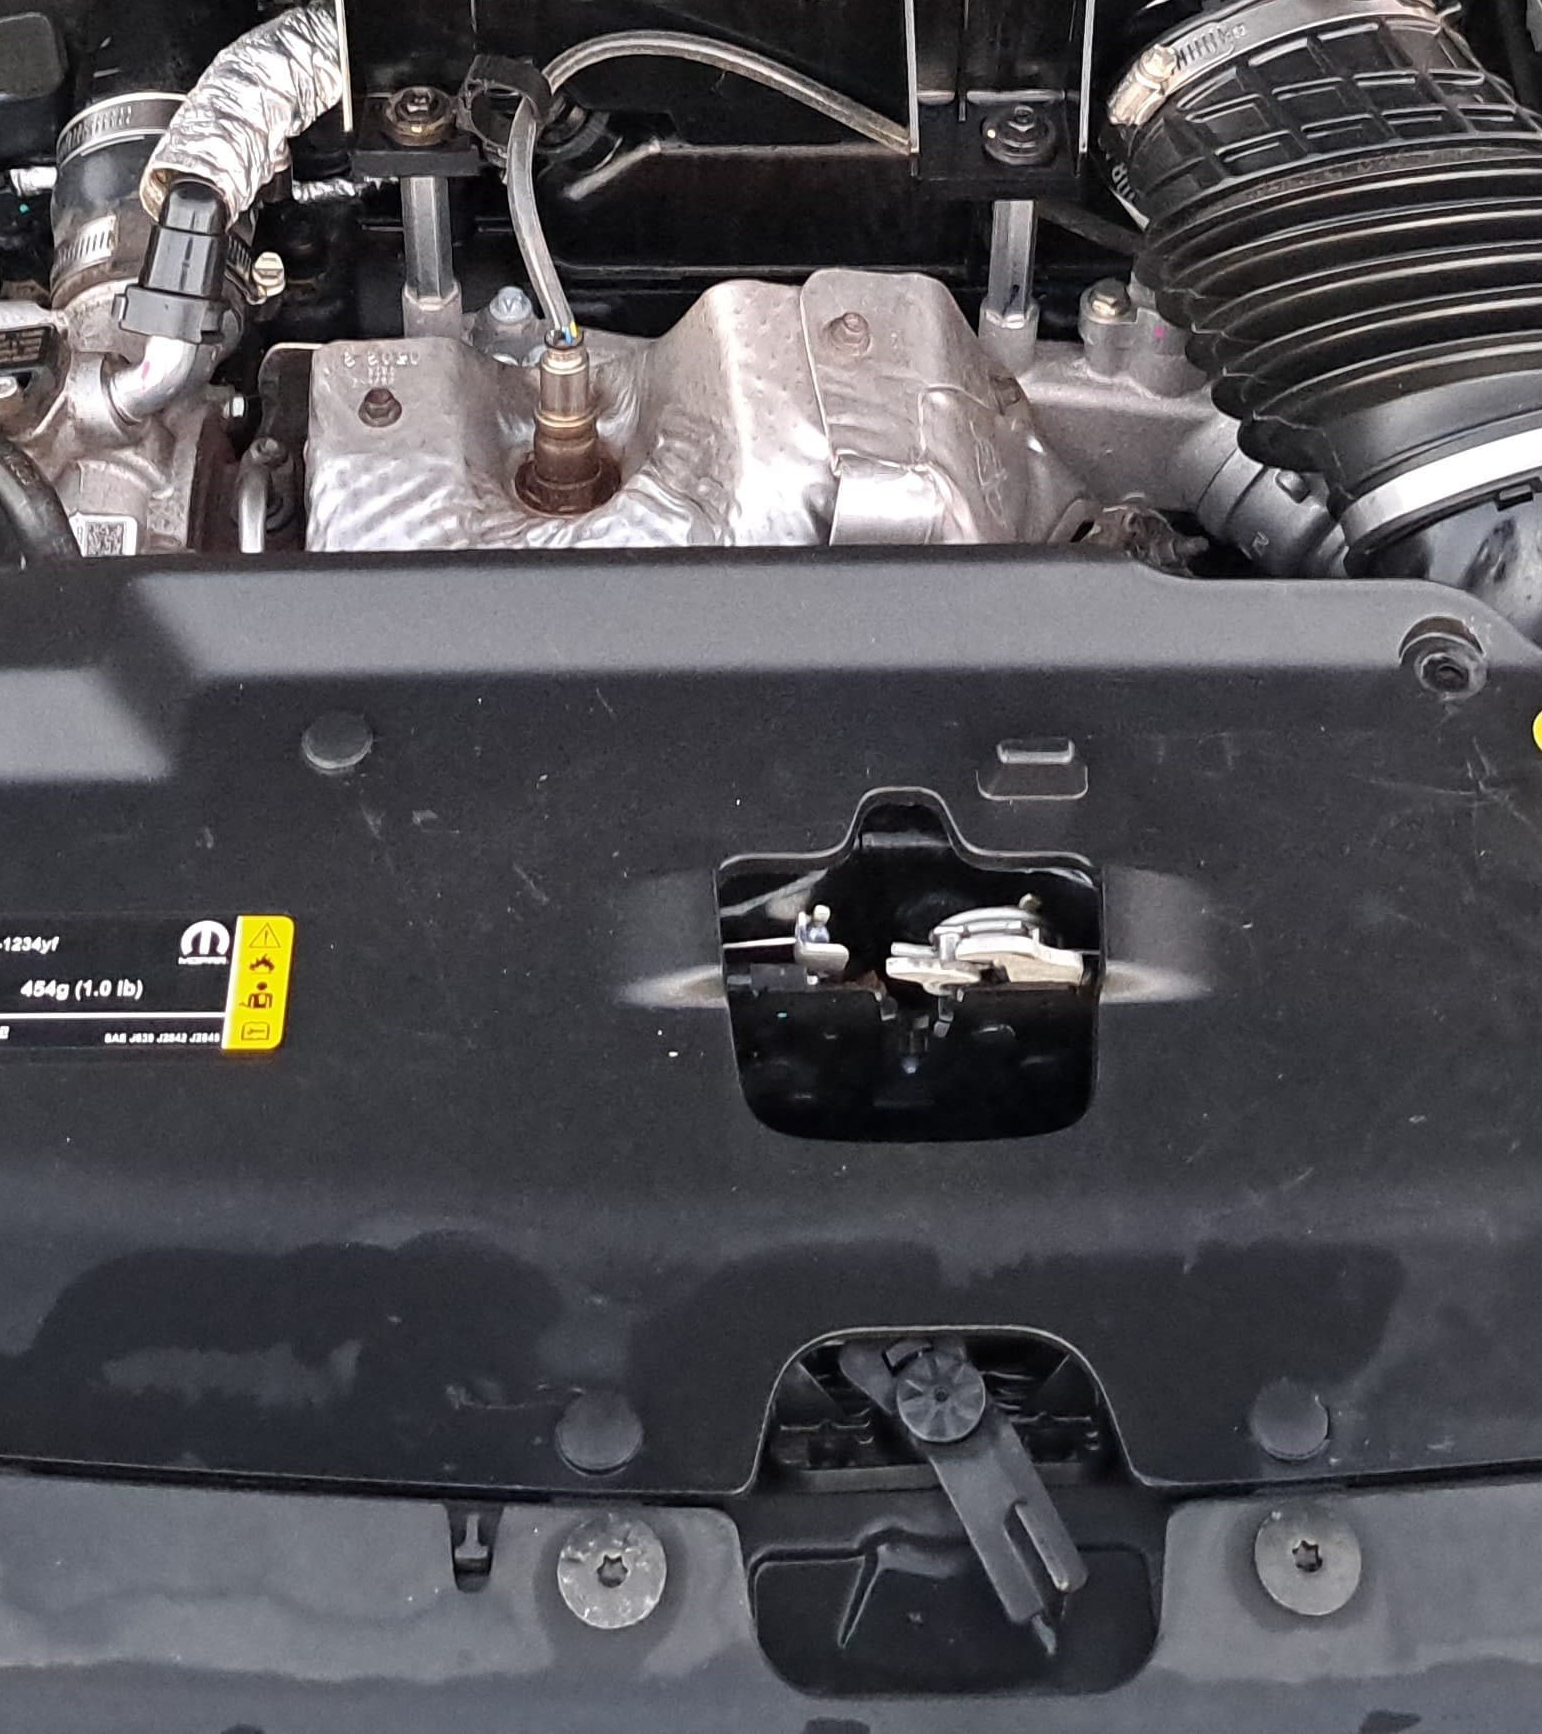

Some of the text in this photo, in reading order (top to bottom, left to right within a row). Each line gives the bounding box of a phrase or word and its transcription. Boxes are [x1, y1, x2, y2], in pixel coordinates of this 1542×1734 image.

[20, 978, 144, 1001] 454g (1.0 lb)
[104, 1032, 127, 1044] SAE
